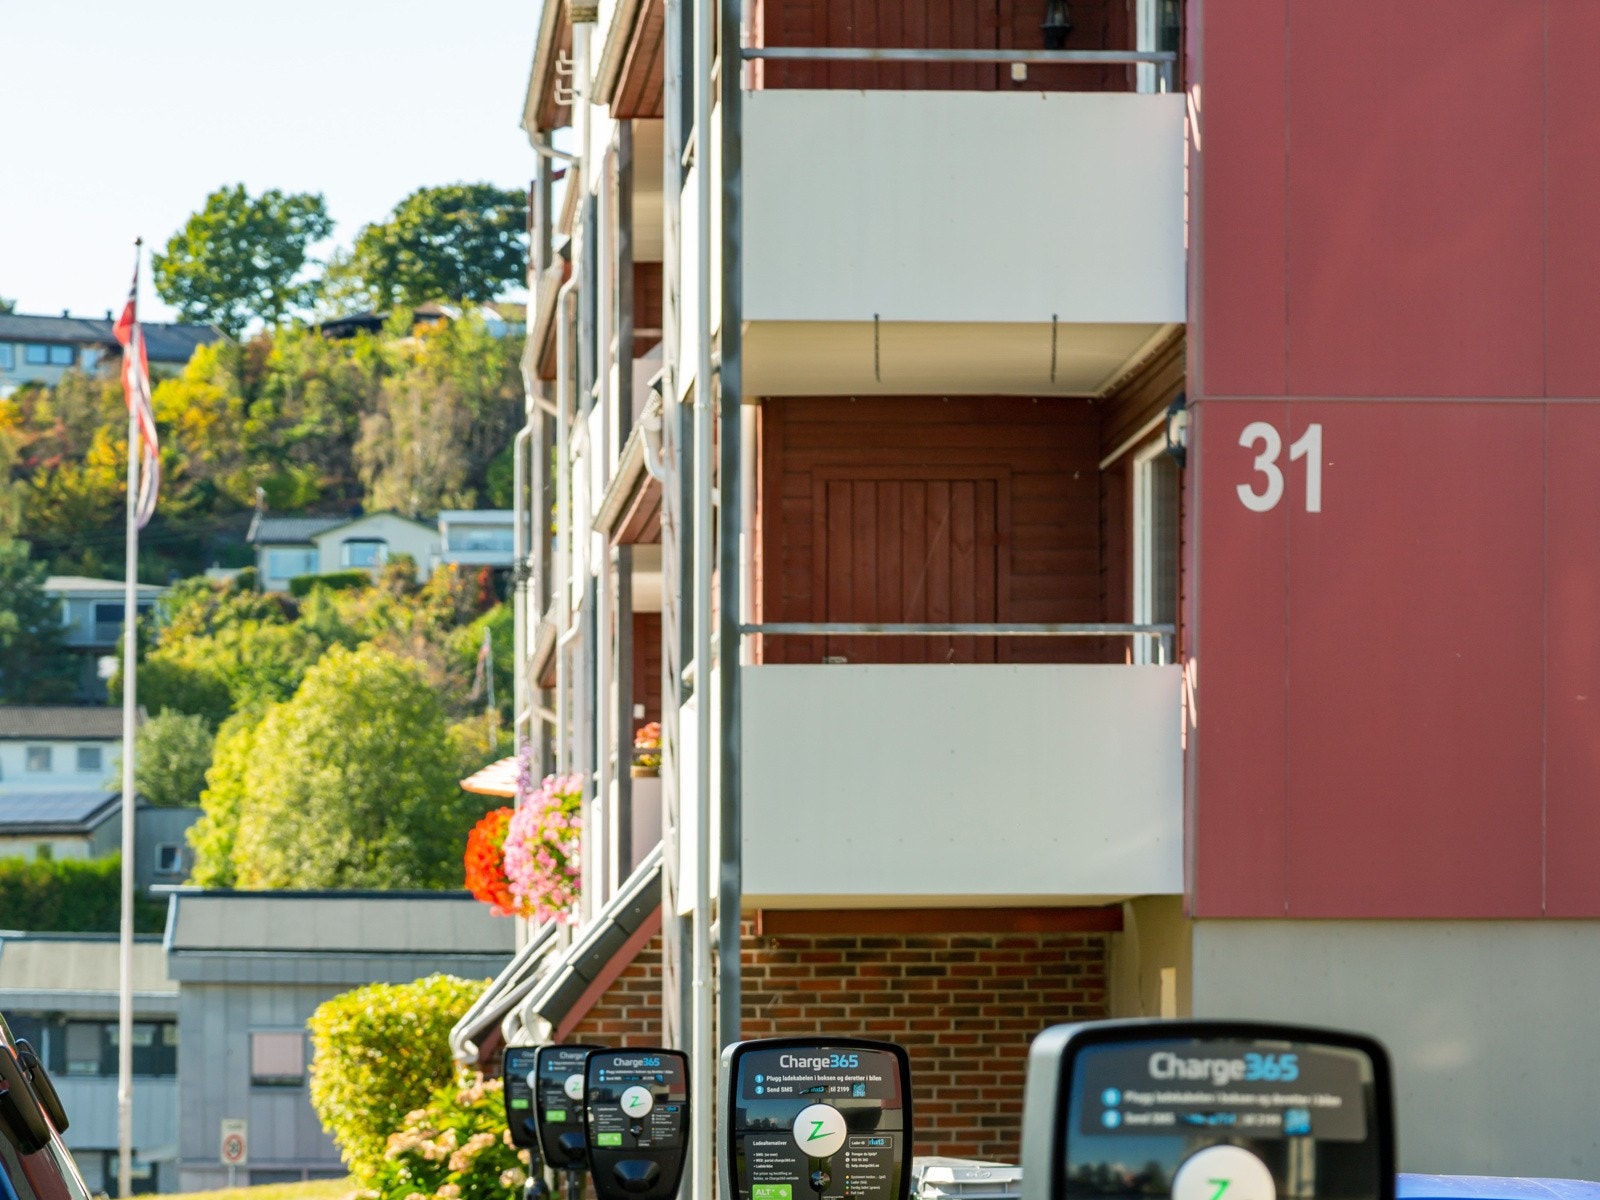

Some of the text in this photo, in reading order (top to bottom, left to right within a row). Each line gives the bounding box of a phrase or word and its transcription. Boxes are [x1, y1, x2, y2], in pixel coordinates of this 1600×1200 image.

[1236, 421, 1323, 513] 31
[559, 1051, 586, 1060] Charge
[614, 1058, 660, 1068] Charge365
[779, 1054, 859, 1071] Charge365
[1148, 1052, 1299, 1085] Charge365
